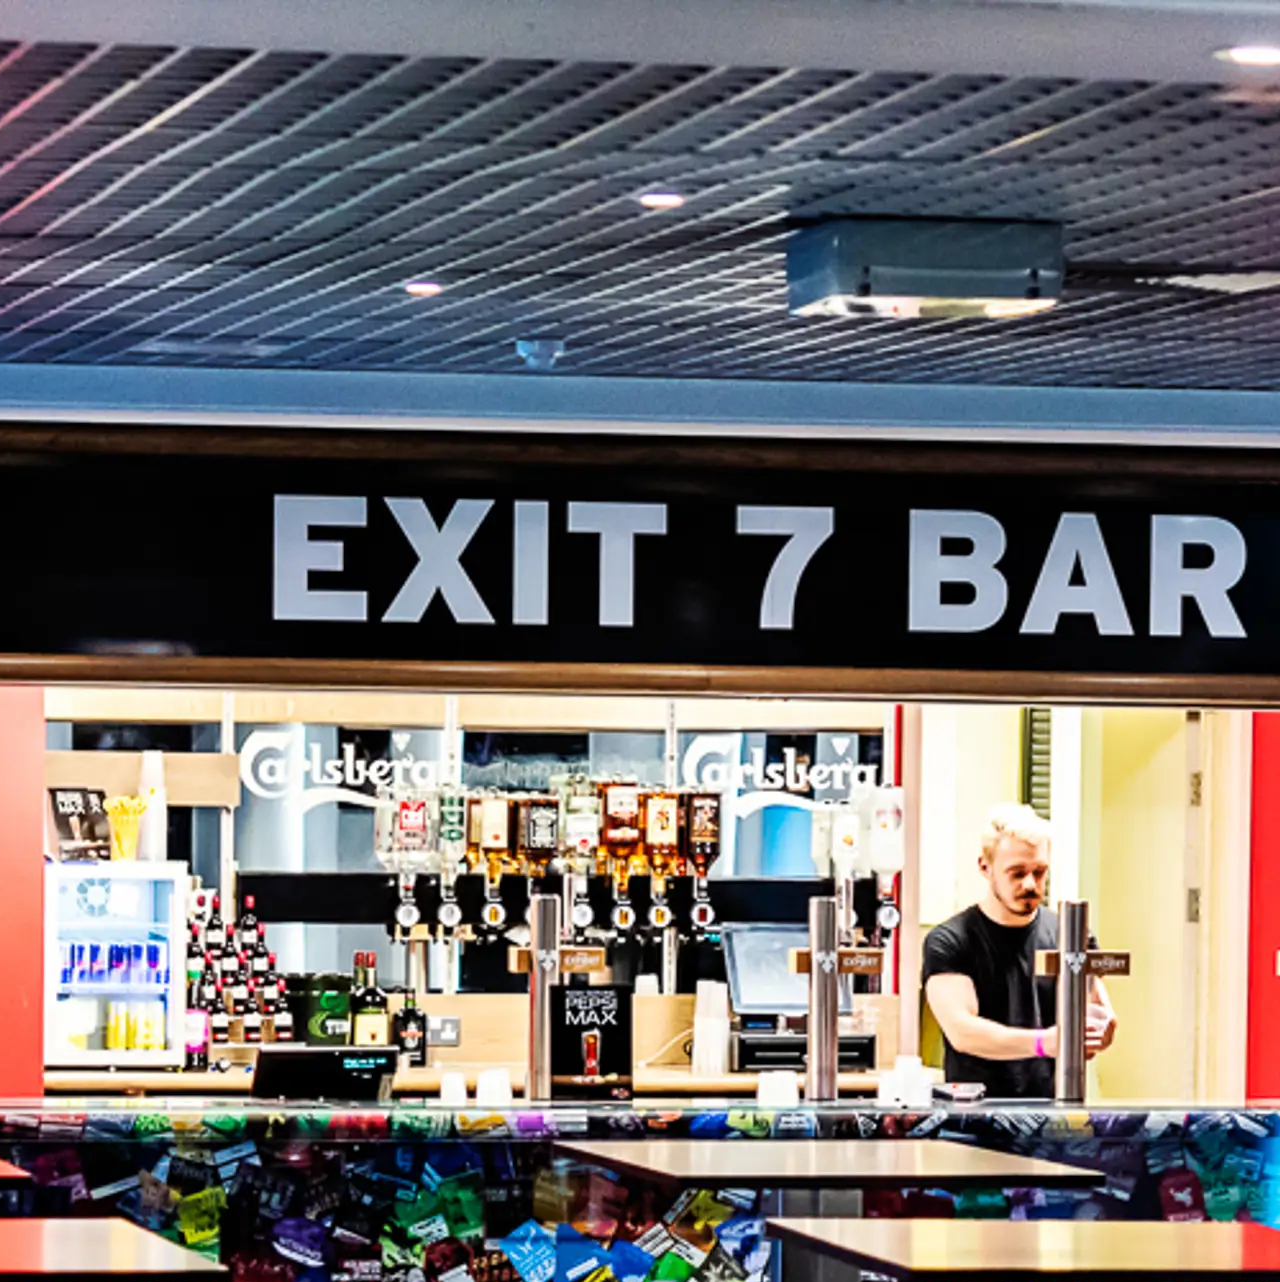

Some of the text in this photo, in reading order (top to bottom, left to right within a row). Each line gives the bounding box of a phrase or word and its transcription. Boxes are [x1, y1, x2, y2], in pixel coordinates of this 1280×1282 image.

[272, 494, 1248, 638] EXIT 7 BAR
[565, 997, 618, 1010] PEPSI
[565, 1010, 618, 1026] MAX
